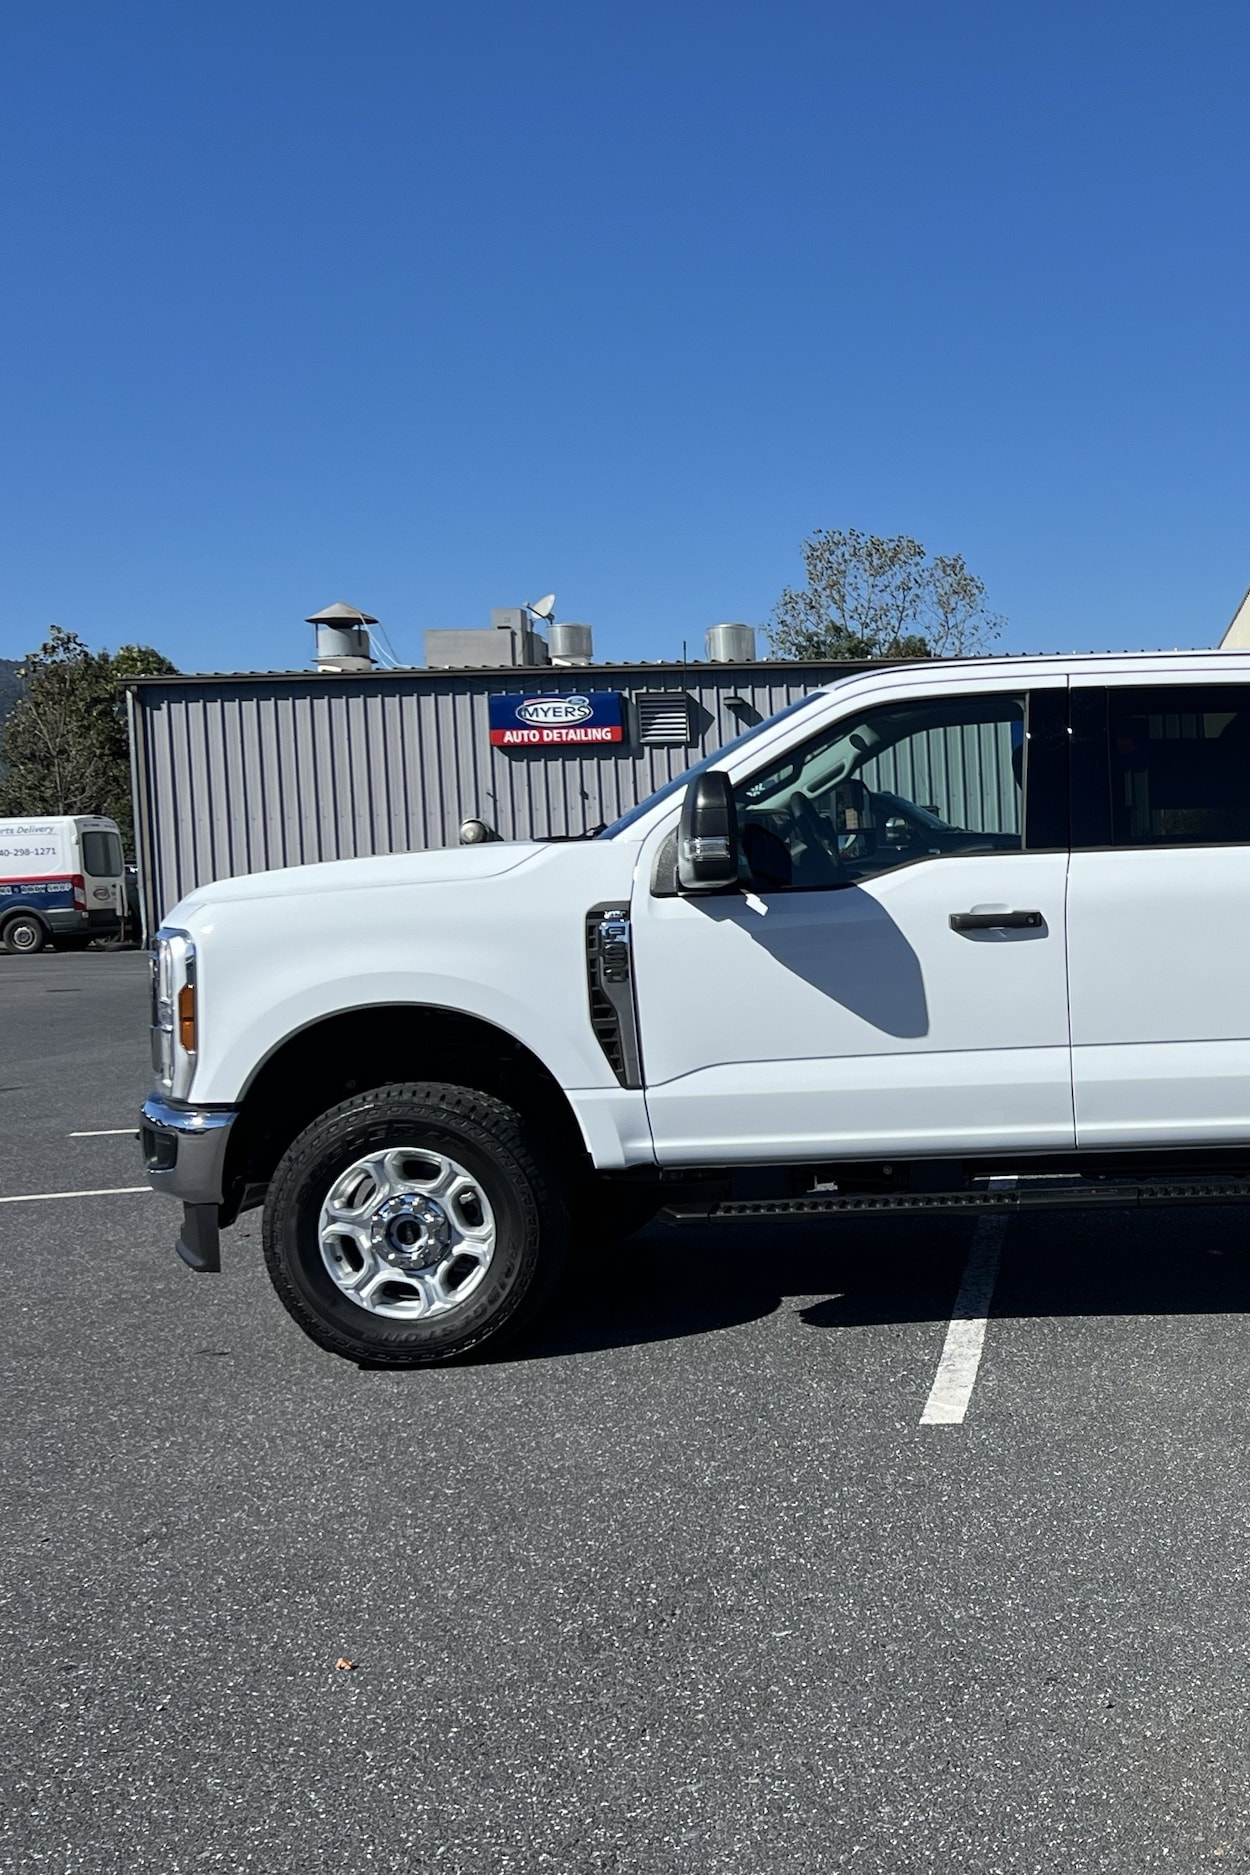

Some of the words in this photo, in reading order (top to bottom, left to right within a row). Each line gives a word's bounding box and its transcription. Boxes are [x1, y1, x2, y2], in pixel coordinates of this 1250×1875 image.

[523, 705, 588, 718] MYERS
[503, 730, 540, 743] AUTO
[542, 727, 612, 741] DETAILING
[16, 826, 55, 835] Delivery
